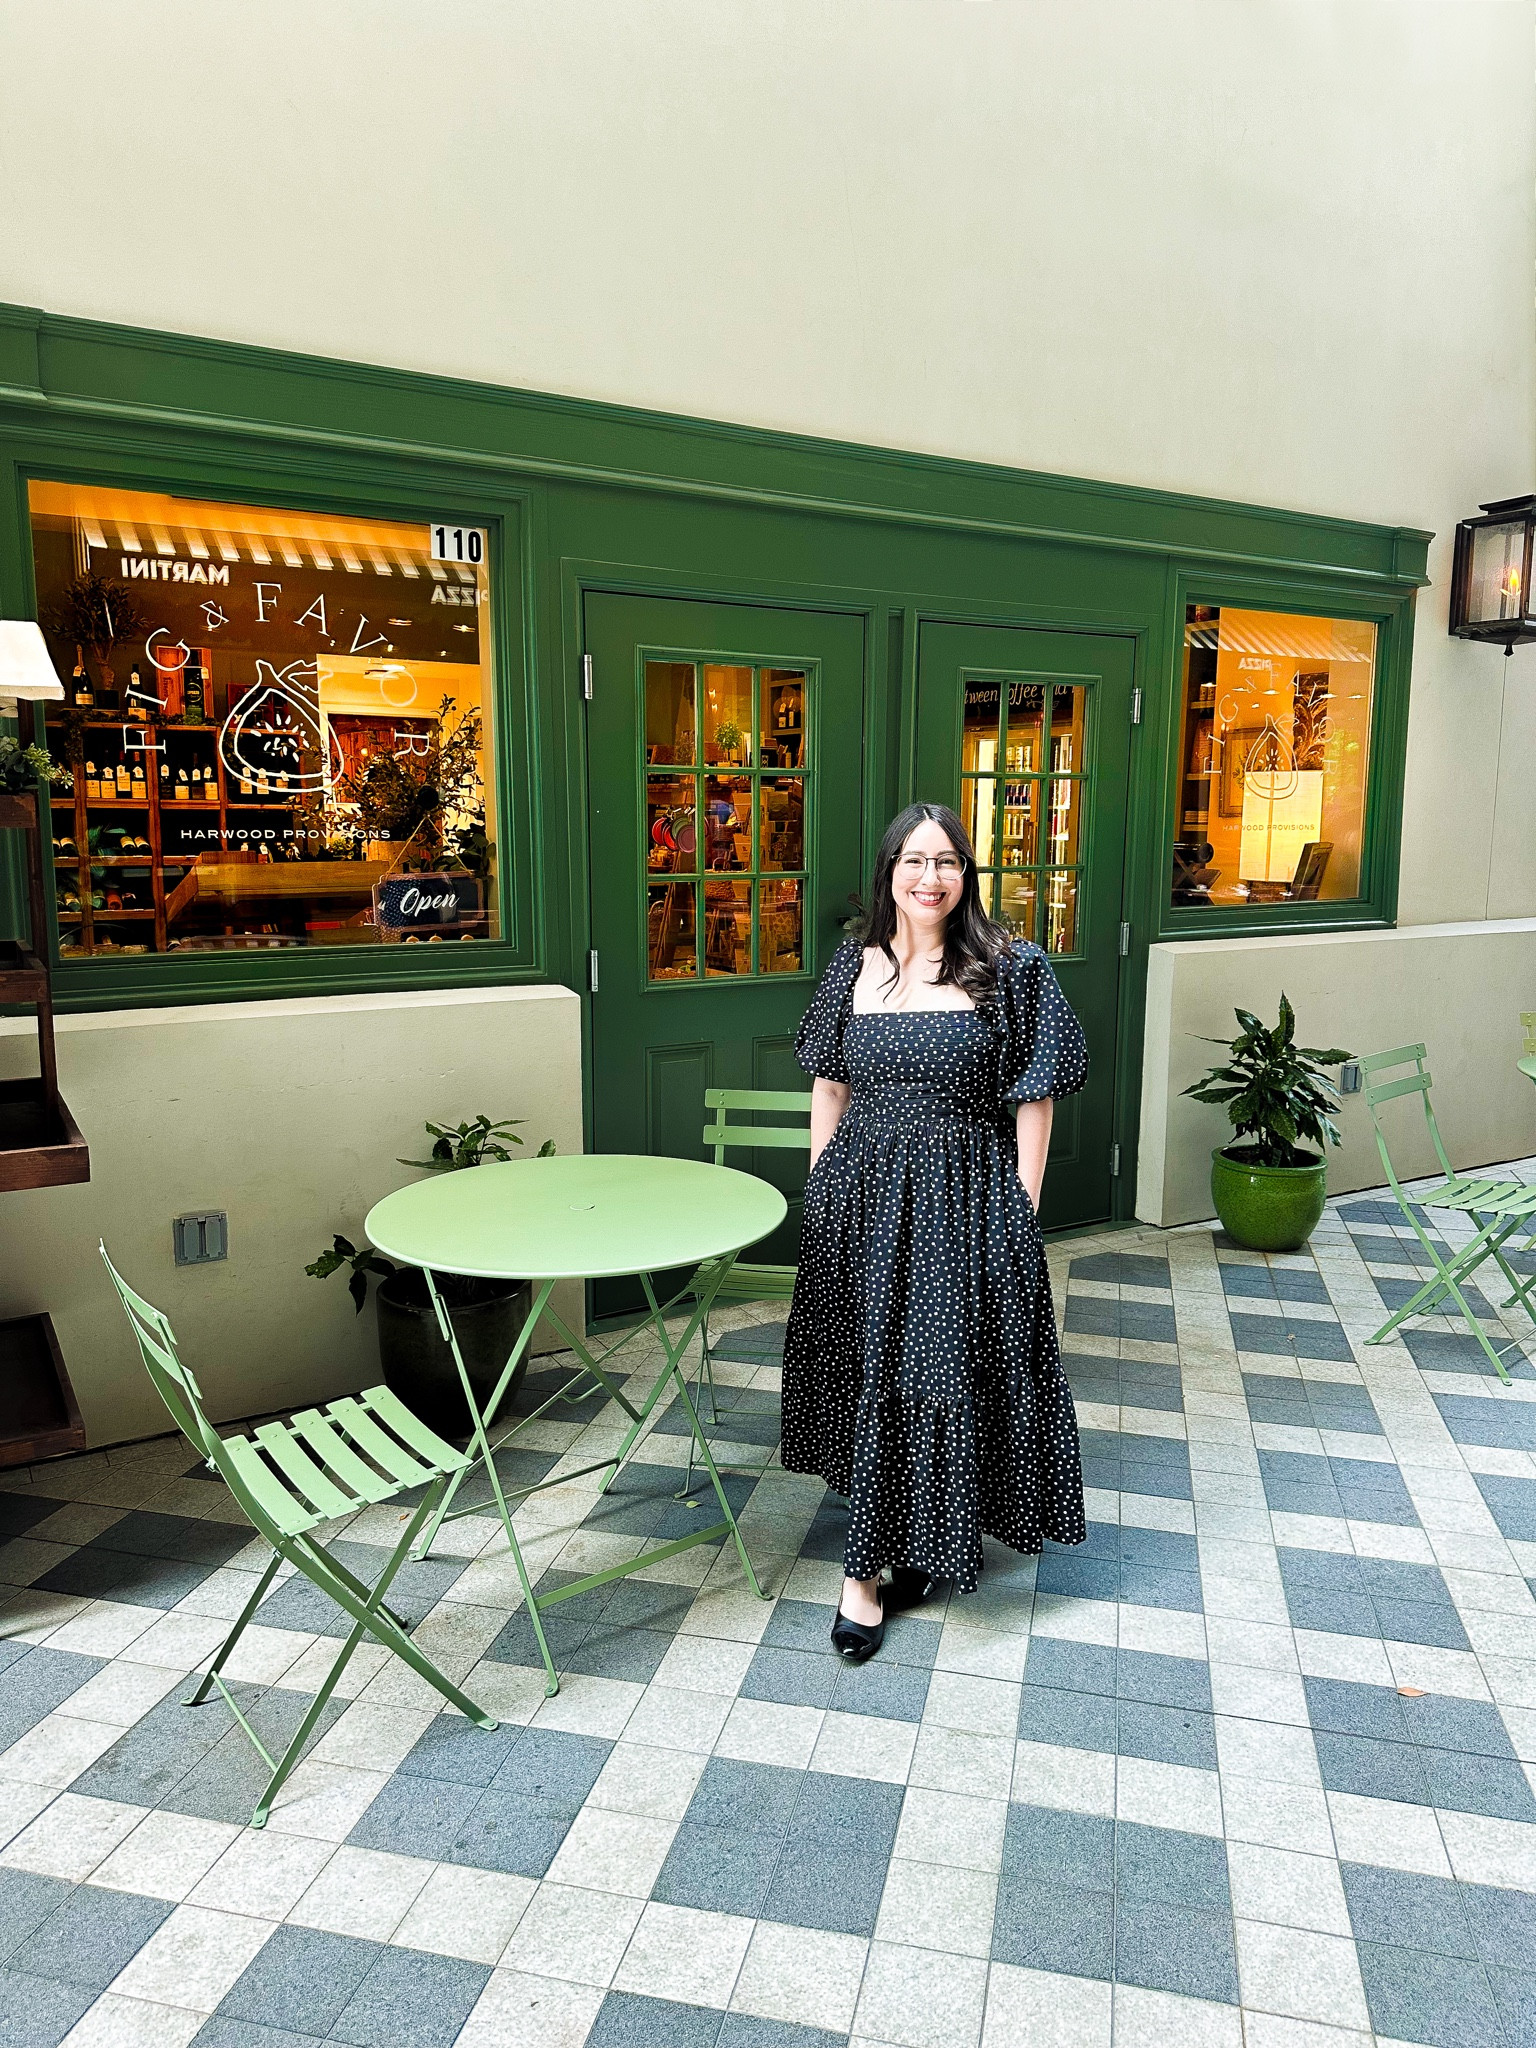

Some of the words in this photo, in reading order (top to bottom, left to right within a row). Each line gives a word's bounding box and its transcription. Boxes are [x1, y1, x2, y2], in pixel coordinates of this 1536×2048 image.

[435, 527, 482, 563] 110
[122, 628, 191, 754] FIG
[200, 600, 229, 629] &
[255, 582, 430, 761] FAVOR
[1008, 683, 1038, 705] offee
[1203, 694, 1239, 775] FIG
[1269, 663, 1339, 775] FAVOR
[180, 829, 276, 839] HARWOOD
[283, 829, 391, 839] PROVSIONS
[1266, 823, 1315, 832] PROVISIONS
[400, 888, 460, 917] Open
